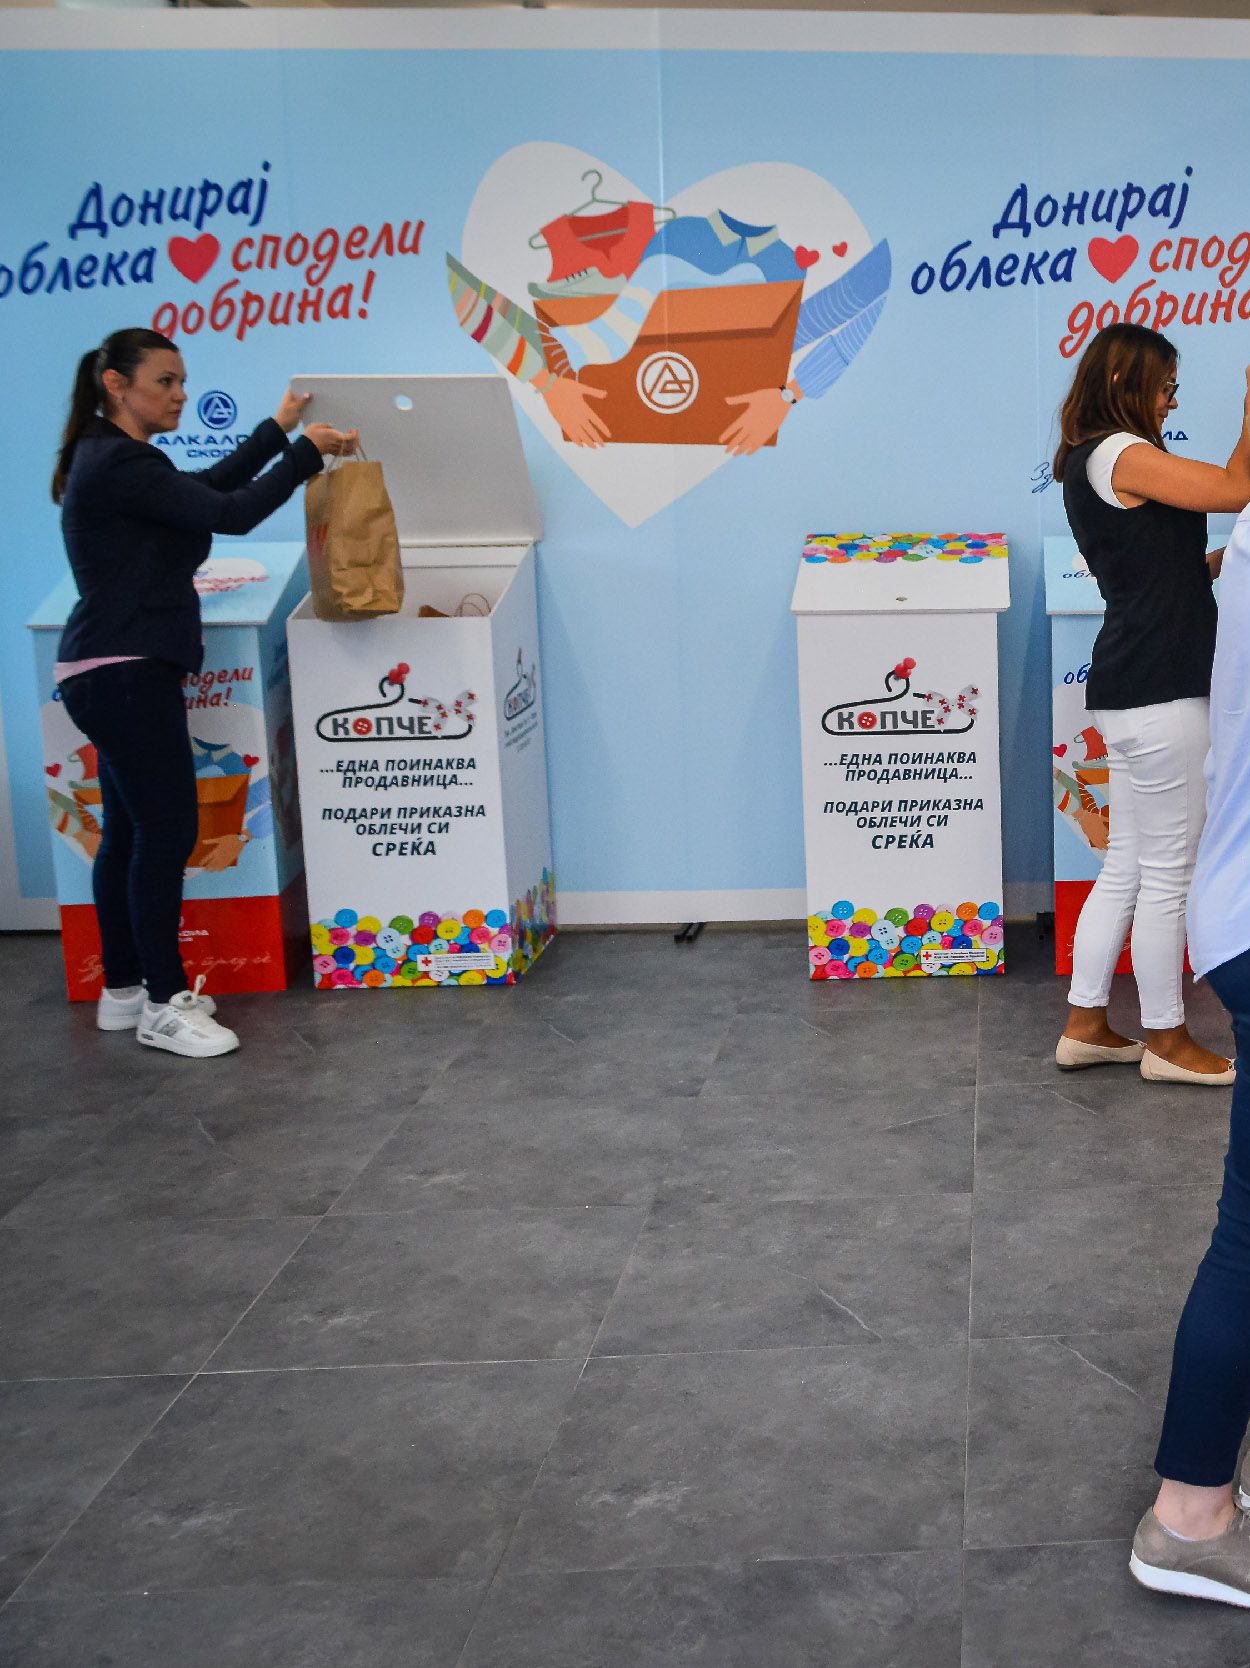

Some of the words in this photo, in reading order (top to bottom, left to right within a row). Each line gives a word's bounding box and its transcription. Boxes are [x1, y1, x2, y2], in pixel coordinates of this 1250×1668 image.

[69, 161, 271, 240] Донирај
[993, 166, 1193, 238] Донирај
[0, 241, 156, 297] облека
[233, 220, 425, 286] сподели
[911, 241, 1077, 294] облека
[152, 271, 375, 342] добрина!
[332, 716, 432, 736] КОПЧЕ
[838, 710, 935, 730] КОПЧЕ
[385, 757, 477, 772] ПОИНАКВА
[888, 751, 977, 765] ПОИНАКВА
[322, 807, 391, 822] ПОДАРИ
[397, 804, 486, 819] ПРИКАЗНА
[824, 799, 893, 815] ПОДАРИ
[898, 798, 984, 812] ПРИКАЗНА
[356, 822, 422, 836] ОБЛЕЧИ
[428, 821, 450, 834] СИ
[856, 815, 922, 829] ОБЛЕЧИ
[926, 814, 949, 828] СИ
